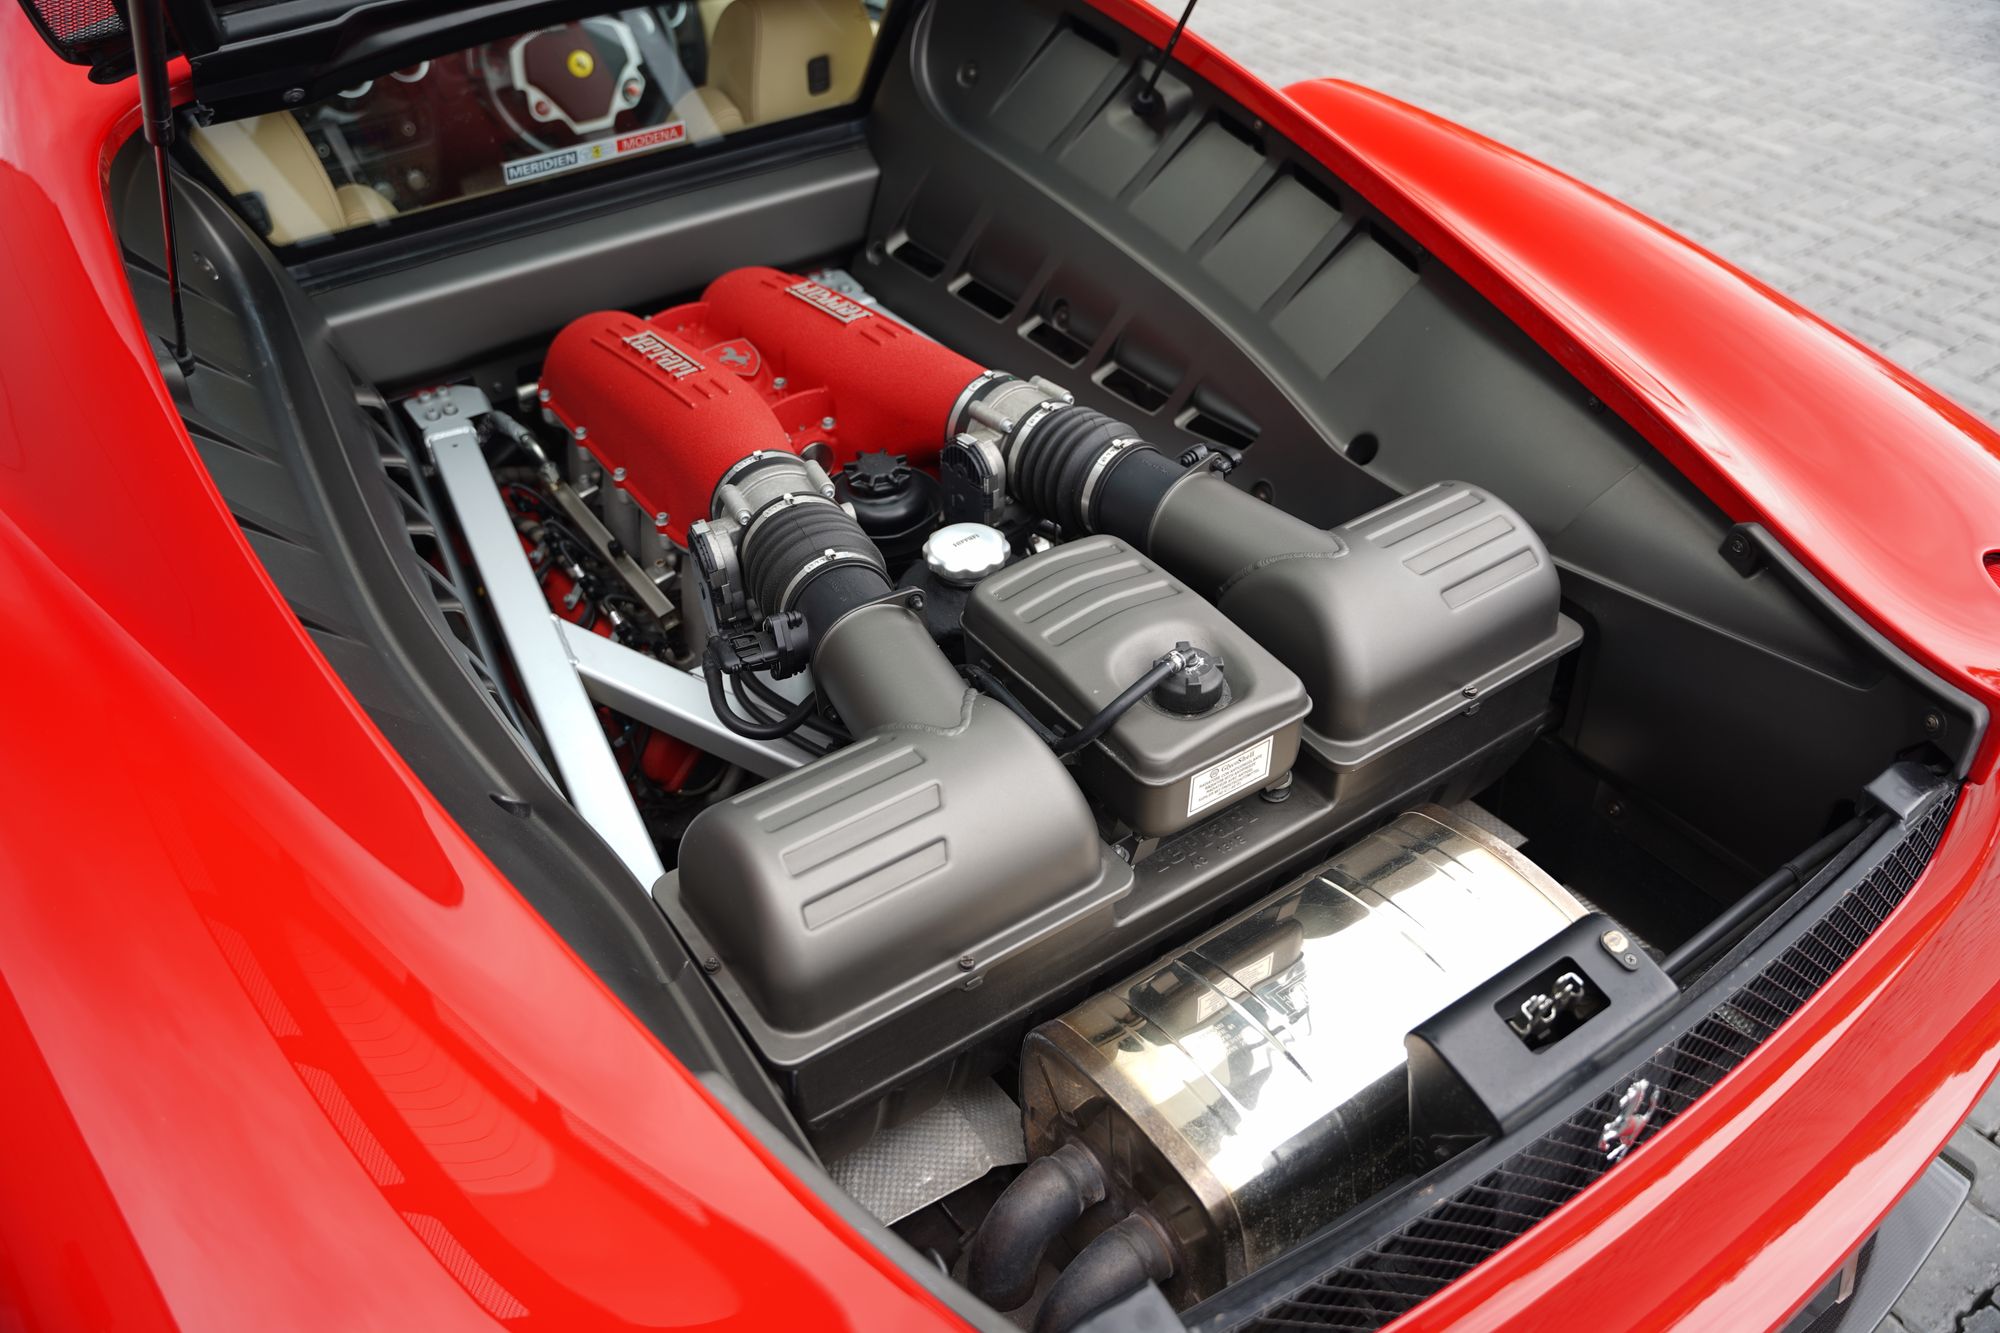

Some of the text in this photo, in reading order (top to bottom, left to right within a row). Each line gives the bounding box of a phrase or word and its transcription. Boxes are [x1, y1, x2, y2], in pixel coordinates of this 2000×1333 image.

[508, 127, 678, 179] MERIDIEN MODENA
[784, 281, 873, 324] Ferrari
[622, 330, 705, 378] Ferrari
